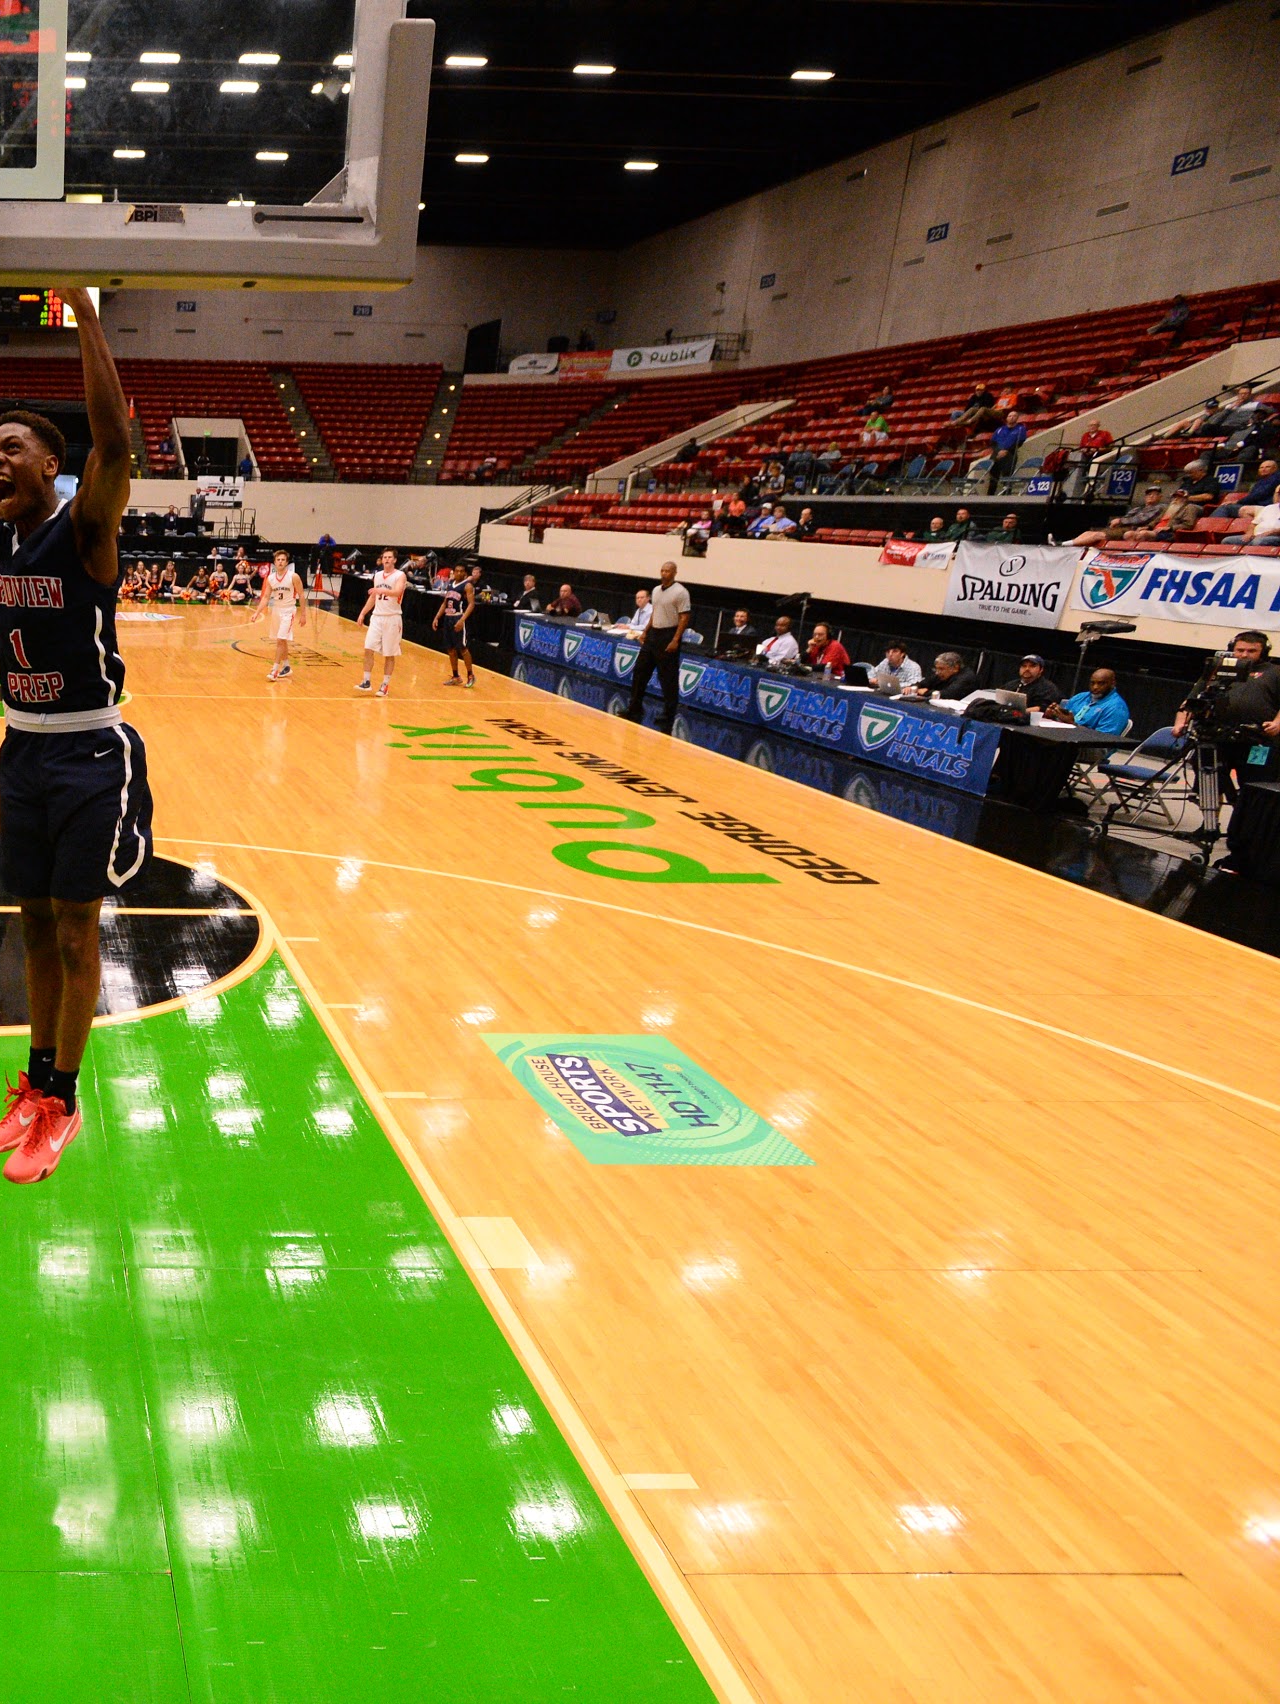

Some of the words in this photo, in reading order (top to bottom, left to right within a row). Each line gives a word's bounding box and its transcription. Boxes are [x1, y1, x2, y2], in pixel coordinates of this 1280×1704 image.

[1175, 150, 1206, 174] 222
[134, 210, 158, 222] BPI
[929, 226, 947, 241] 221
[650, 347, 698, 364] Publix
[1037, 481, 1050, 491] 123
[1111, 470, 1132, 482] 123
[1218, 472, 1236, 484] 124
[957, 574, 1062, 613] SPALDING
[1140, 568, 1261, 610] FHSAA
[978, 604, 992, 612] TRUE
[1000, 606, 1011, 614] THE
[9, 628, 32, 669] 1
[533, 623, 562, 645] FHSAA
[581, 636, 613, 661] FHSAA
[575, 654, 610, 674] FINALS
[7, 671, 64, 704] PREP
[699, 666, 751, 700] FHSAA
[695, 688, 749, 714] FINALS
[788, 686, 848, 726] FHSAA
[484, 718, 574, 746] ARENA
[781, 712, 844, 742] FINALS
[895, 714, 977, 762] FHSAA
[887, 742, 970, 778] FINALS
[554, 751, 699, 803] JENKINS
[384, 723, 782, 884] Publix
[677, 811, 880, 885] GEORGE
[531, 1058, 564, 1089] HOUSE
[623, 1062, 683, 1096] 1147
[554, 1055, 651, 1136] SPORTS
[597, 1067, 660, 1120] NETWORK
[556, 1091, 609, 1130] BRIGHT
[668, 1099, 720, 1128] HD
